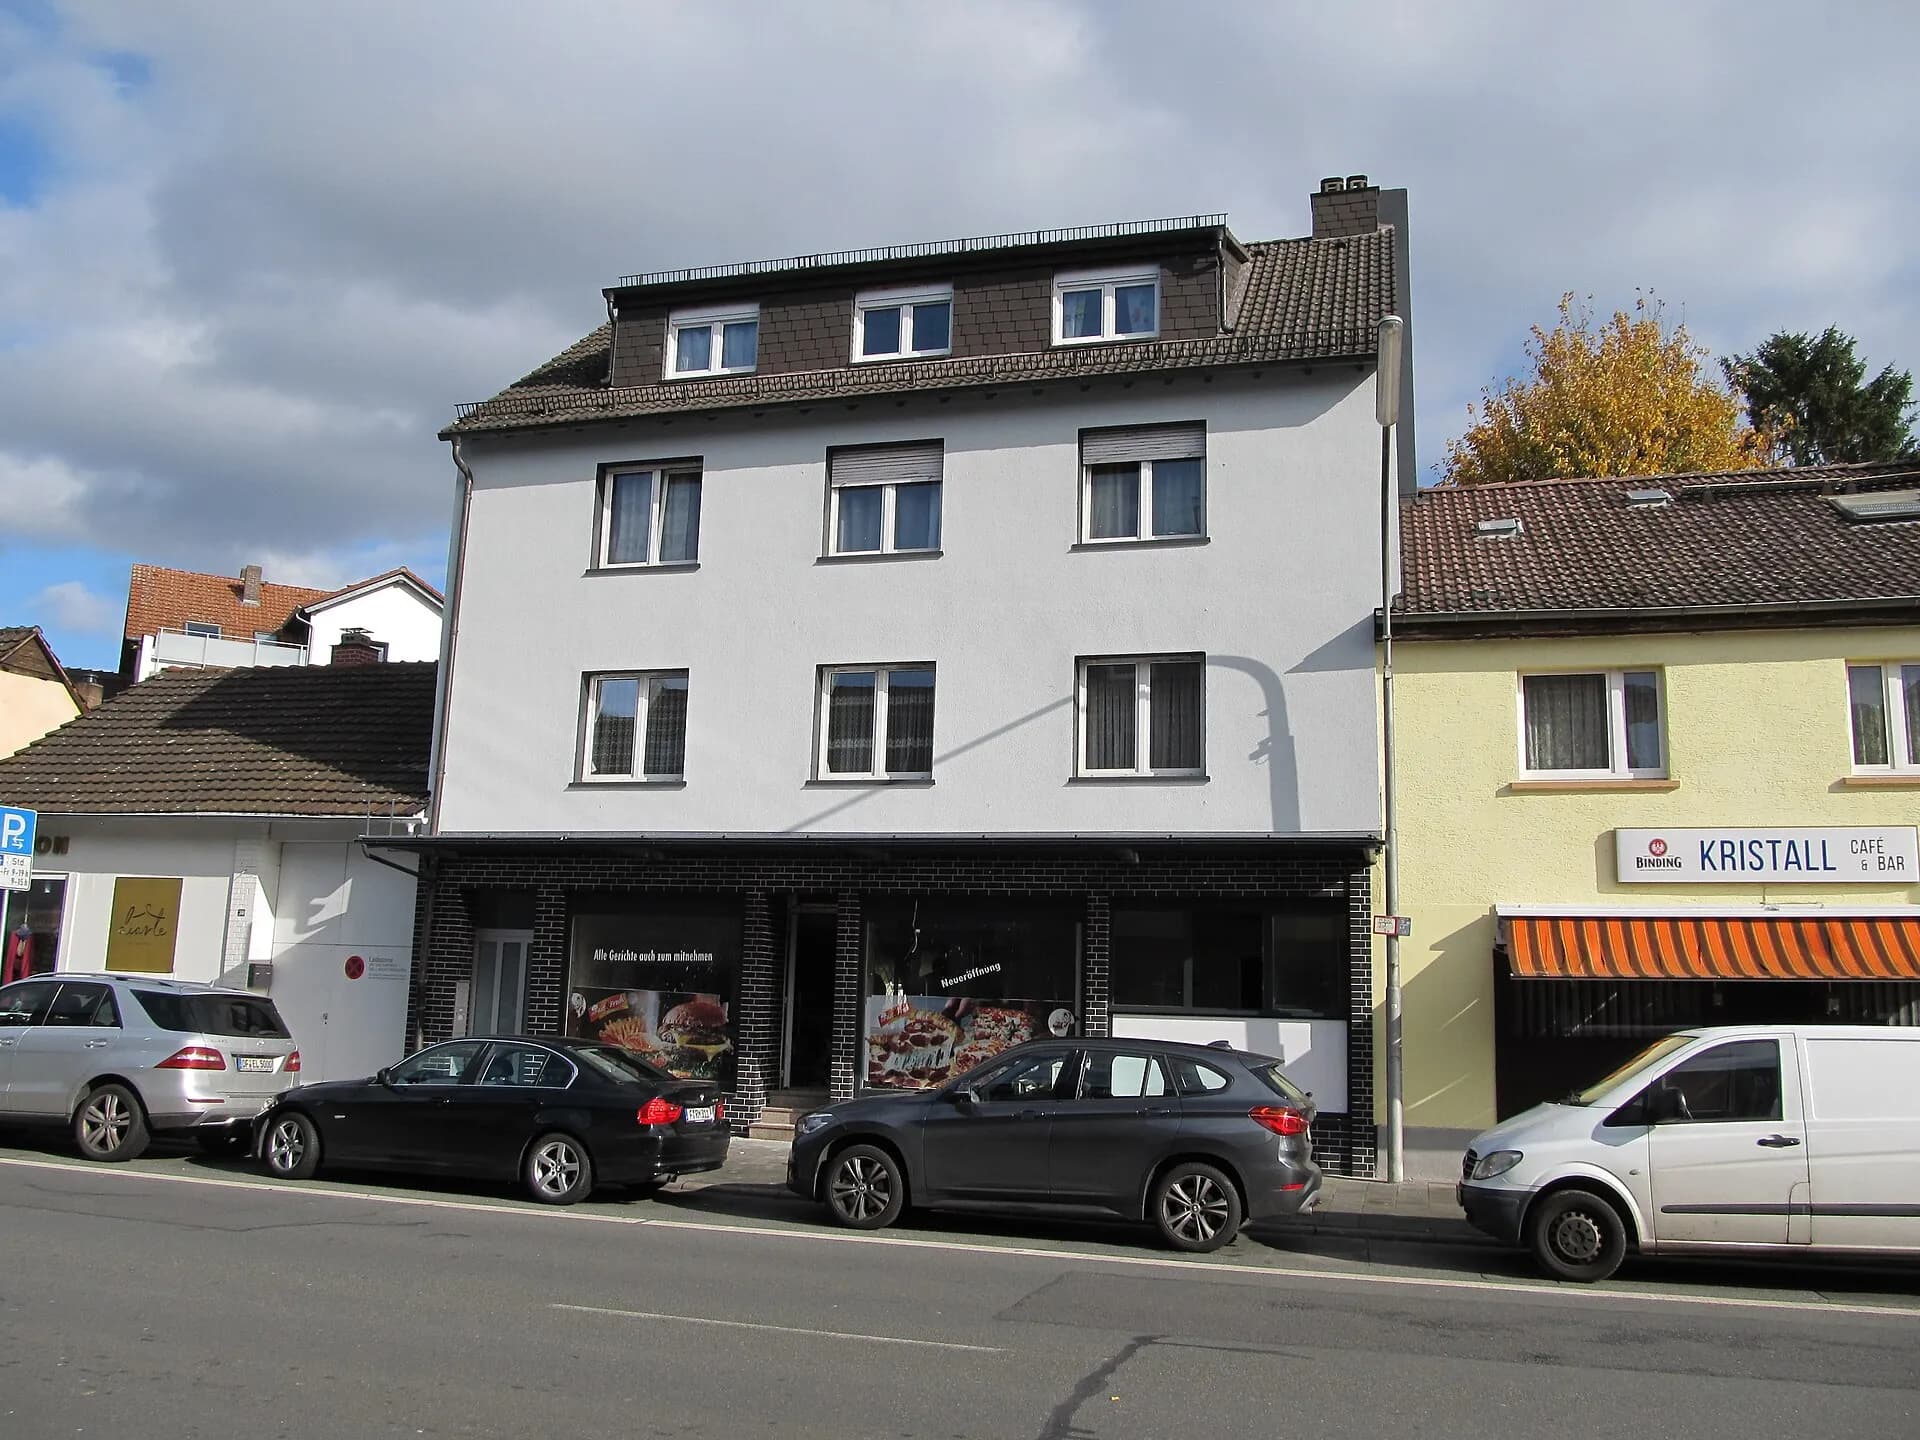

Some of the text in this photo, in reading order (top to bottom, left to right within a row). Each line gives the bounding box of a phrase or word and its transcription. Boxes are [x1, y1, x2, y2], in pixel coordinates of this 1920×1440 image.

[2, 813, 26, 849] P
[1850, 836, 1885, 854] CAFÉ
[1636, 856, 1682, 869] BINDING
[1700, 839, 1837, 871] KRISTALL
[1861, 855, 1905, 871] & BAR
[593, 948, 713, 962] Alle Gerichte auch zum mitnehmen
[940, 962, 1001, 988] Neueröffnung
